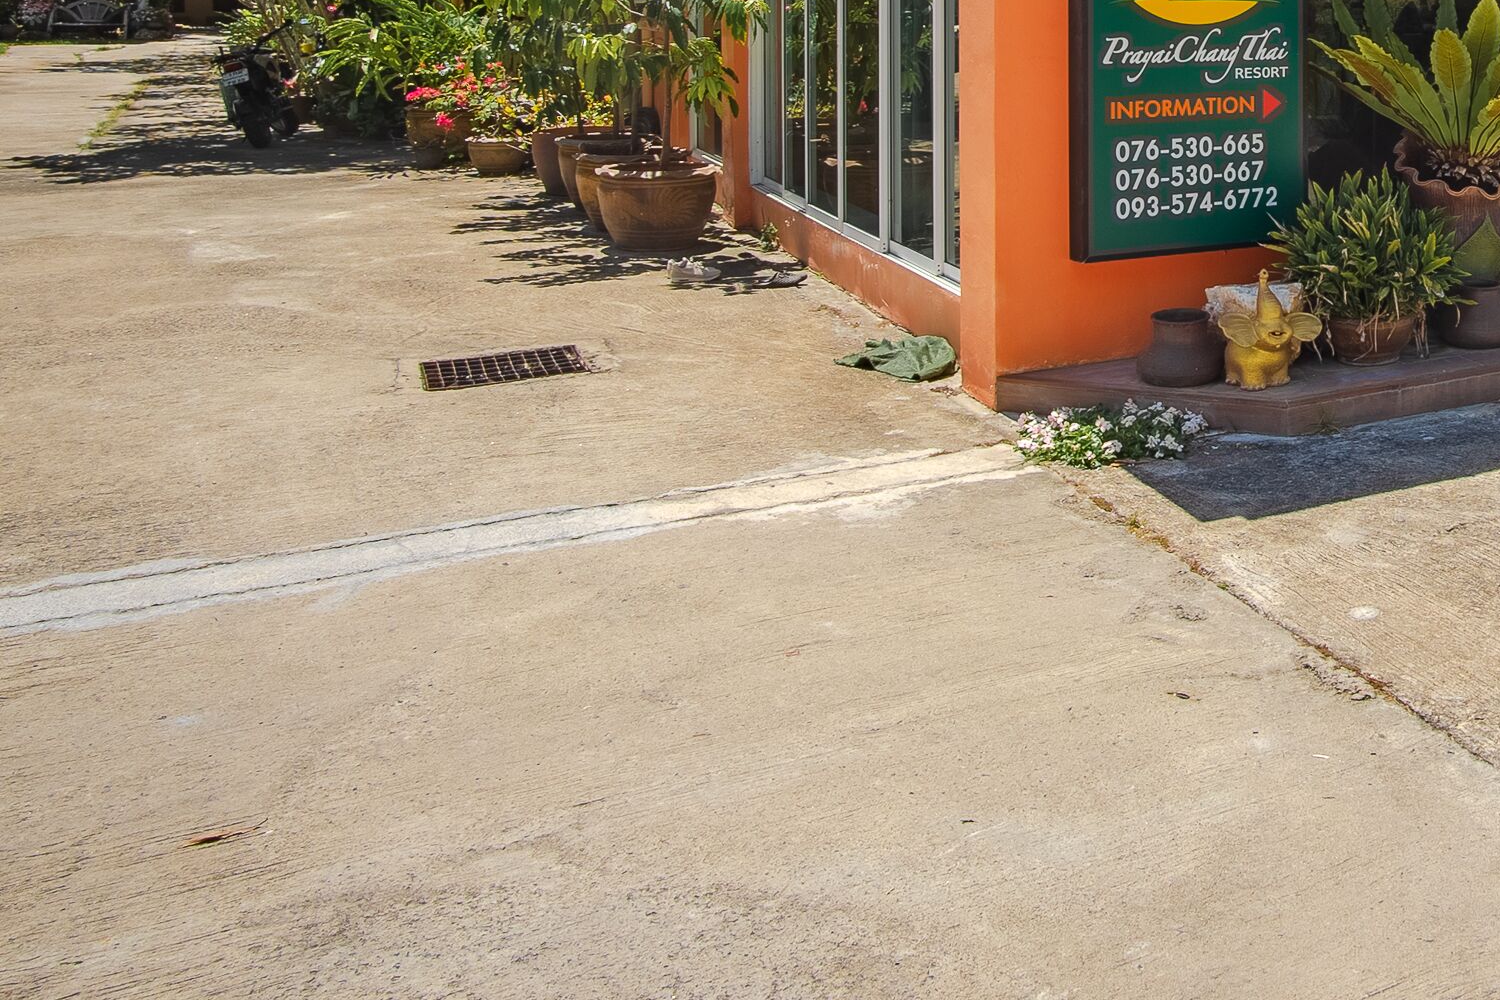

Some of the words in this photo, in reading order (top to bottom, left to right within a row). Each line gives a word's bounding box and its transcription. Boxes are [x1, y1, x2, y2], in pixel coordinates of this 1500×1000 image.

[1234, 66, 1289, 80] RESORT
[1110, 95, 1255, 120] INFORMATION
[1115, 133, 1264, 163] 076-530-665
[1115, 160, 1264, 191] 076-530-667
[1115, 186, 1278, 220] 093-574-6772
